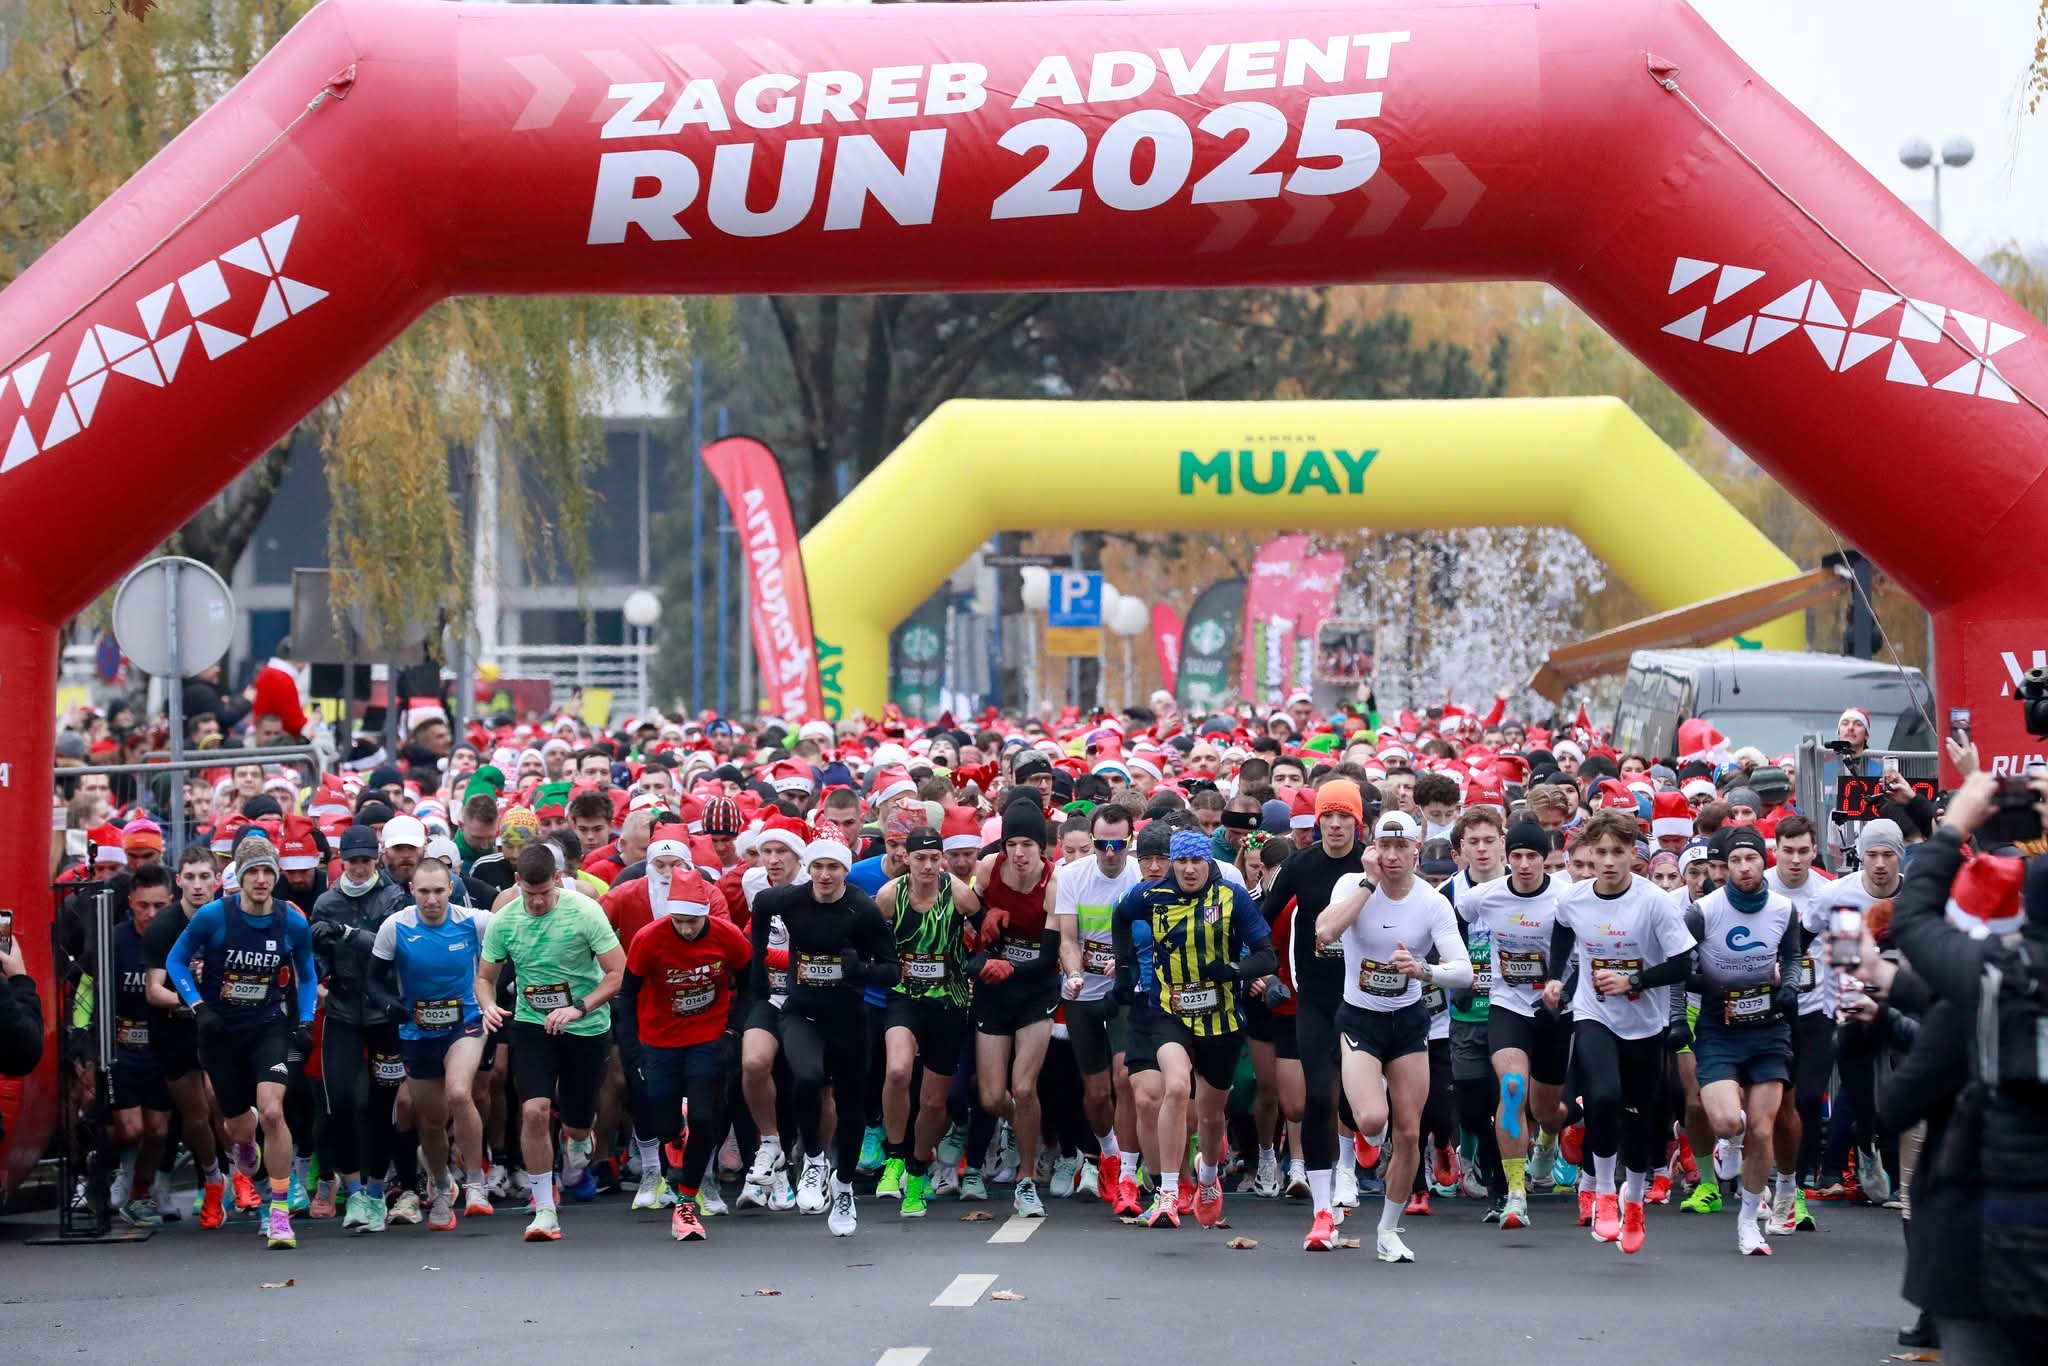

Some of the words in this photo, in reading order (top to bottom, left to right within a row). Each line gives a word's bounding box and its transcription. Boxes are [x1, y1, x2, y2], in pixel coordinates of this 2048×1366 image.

[600, 62, 988, 139] ZAGREB
[1011, 30, 1411, 109] ADVENT
[587, 128, 947, 246] RUN
[990, 91, 1382, 220] 2025
[1179, 450, 1380, 495] MUAY
[1061, 573, 1090, 613] P
[226, 949, 281, 968] ZAGREB
[1007, 947, 1033, 959] 0378
[810, 966, 833, 974] 0136
[912, 964, 937, 973] 0326
[1510, 963, 1533, 971] 0107
[1372, 973, 1399, 984] 0224
[535, 995, 559, 1004] 0263
[1182, 993, 1208, 1003] 0237
[425, 1010, 451, 1019] 0024
